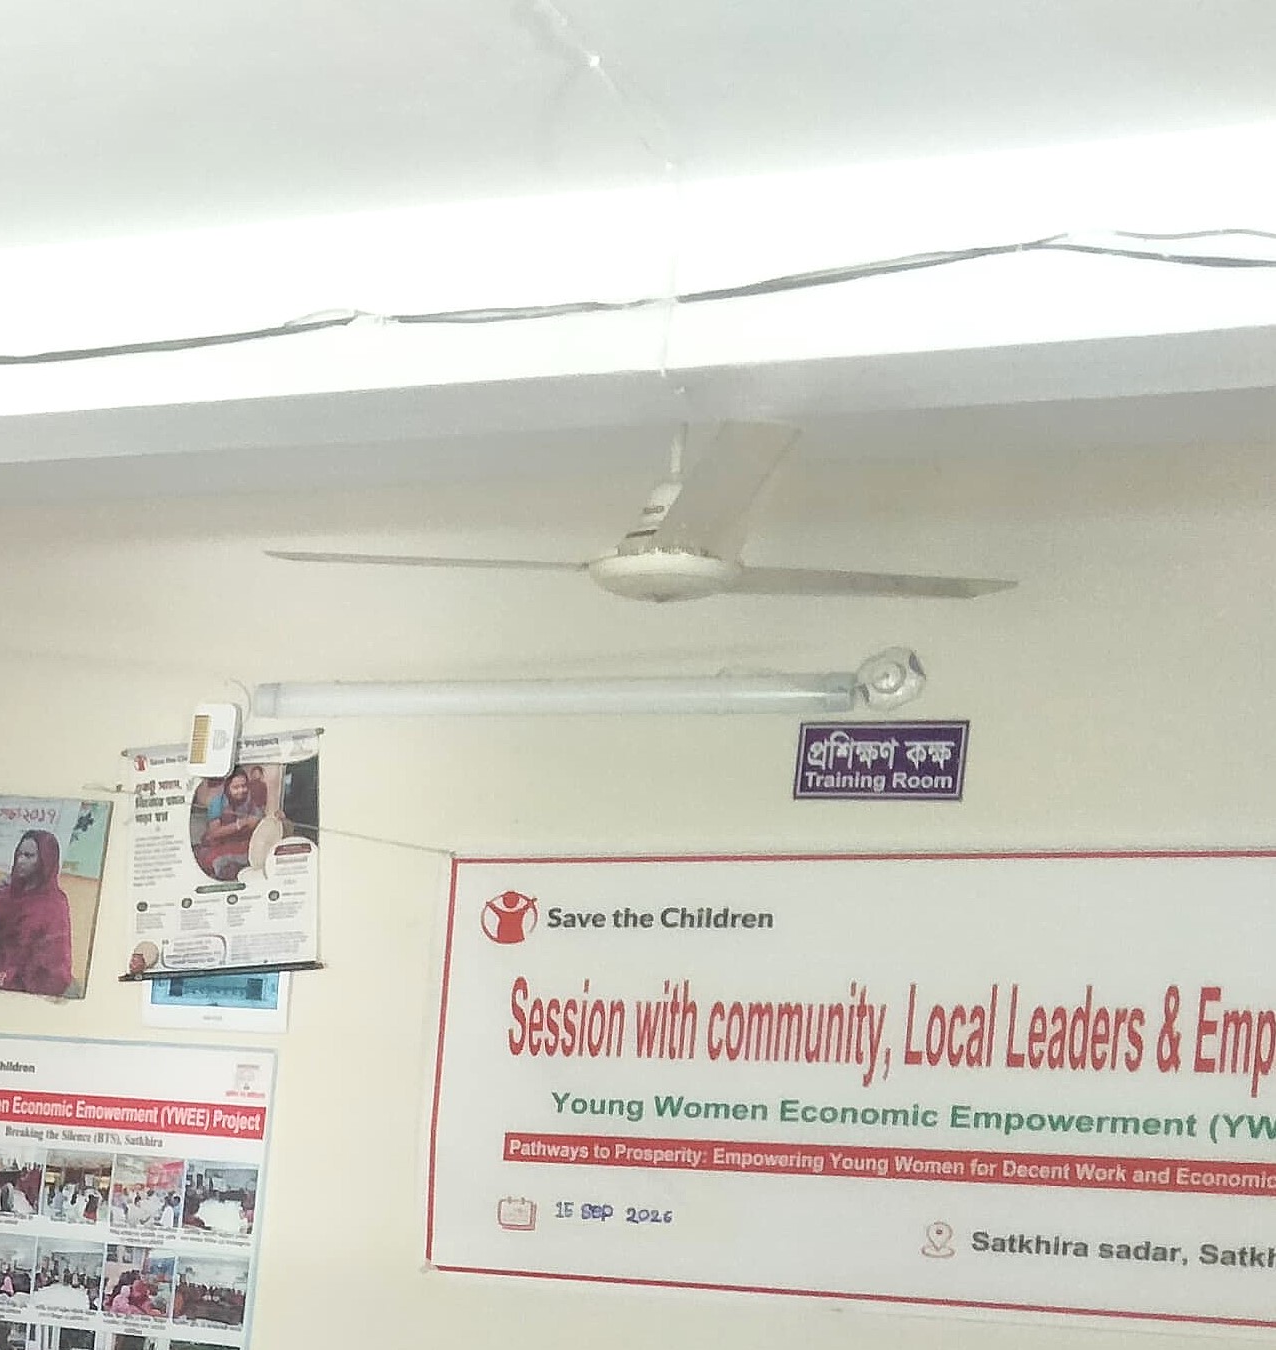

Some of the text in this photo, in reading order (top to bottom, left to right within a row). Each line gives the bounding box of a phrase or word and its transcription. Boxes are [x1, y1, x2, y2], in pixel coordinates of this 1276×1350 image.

[807, 731, 955, 770] প্রশিক্ষণ কক্ষ
[806, 772, 953, 792] Training Room
[547, 907, 773, 929] Save the Children
[508, 976, 625, 1058] Session
[636, 979, 698, 1060] with
[707, 980, 892, 1087] community,
[903, 983, 998, 1067] Local
[1006, 983, 1145, 1073] Leaders
[1157, 983, 1182, 1074] &
[12, 1096, 73, 1119] Economic
[160, 1104, 211, 1129] (YWEE)
[213, 1109, 261, 1132] Project
[551, 1092, 644, 1122] Young
[654, 1095, 768, 1122] Women
[780, 1099, 938, 1128] Economic
[950, 1104, 1197, 1137] Empowerment
[5, 1125, 44, 1141] Breaking
[46, 1128, 59, 1140] the
[61, 1130, 91, 1143] Silence
[509, 1139, 1276, 1189] Pathways to Prosperity: Empowering Young Women for Decent Work and Economic
[971, 1230, 1089, 1258] Satkhira
[1098, 1240, 1189, 1266] sadar,
